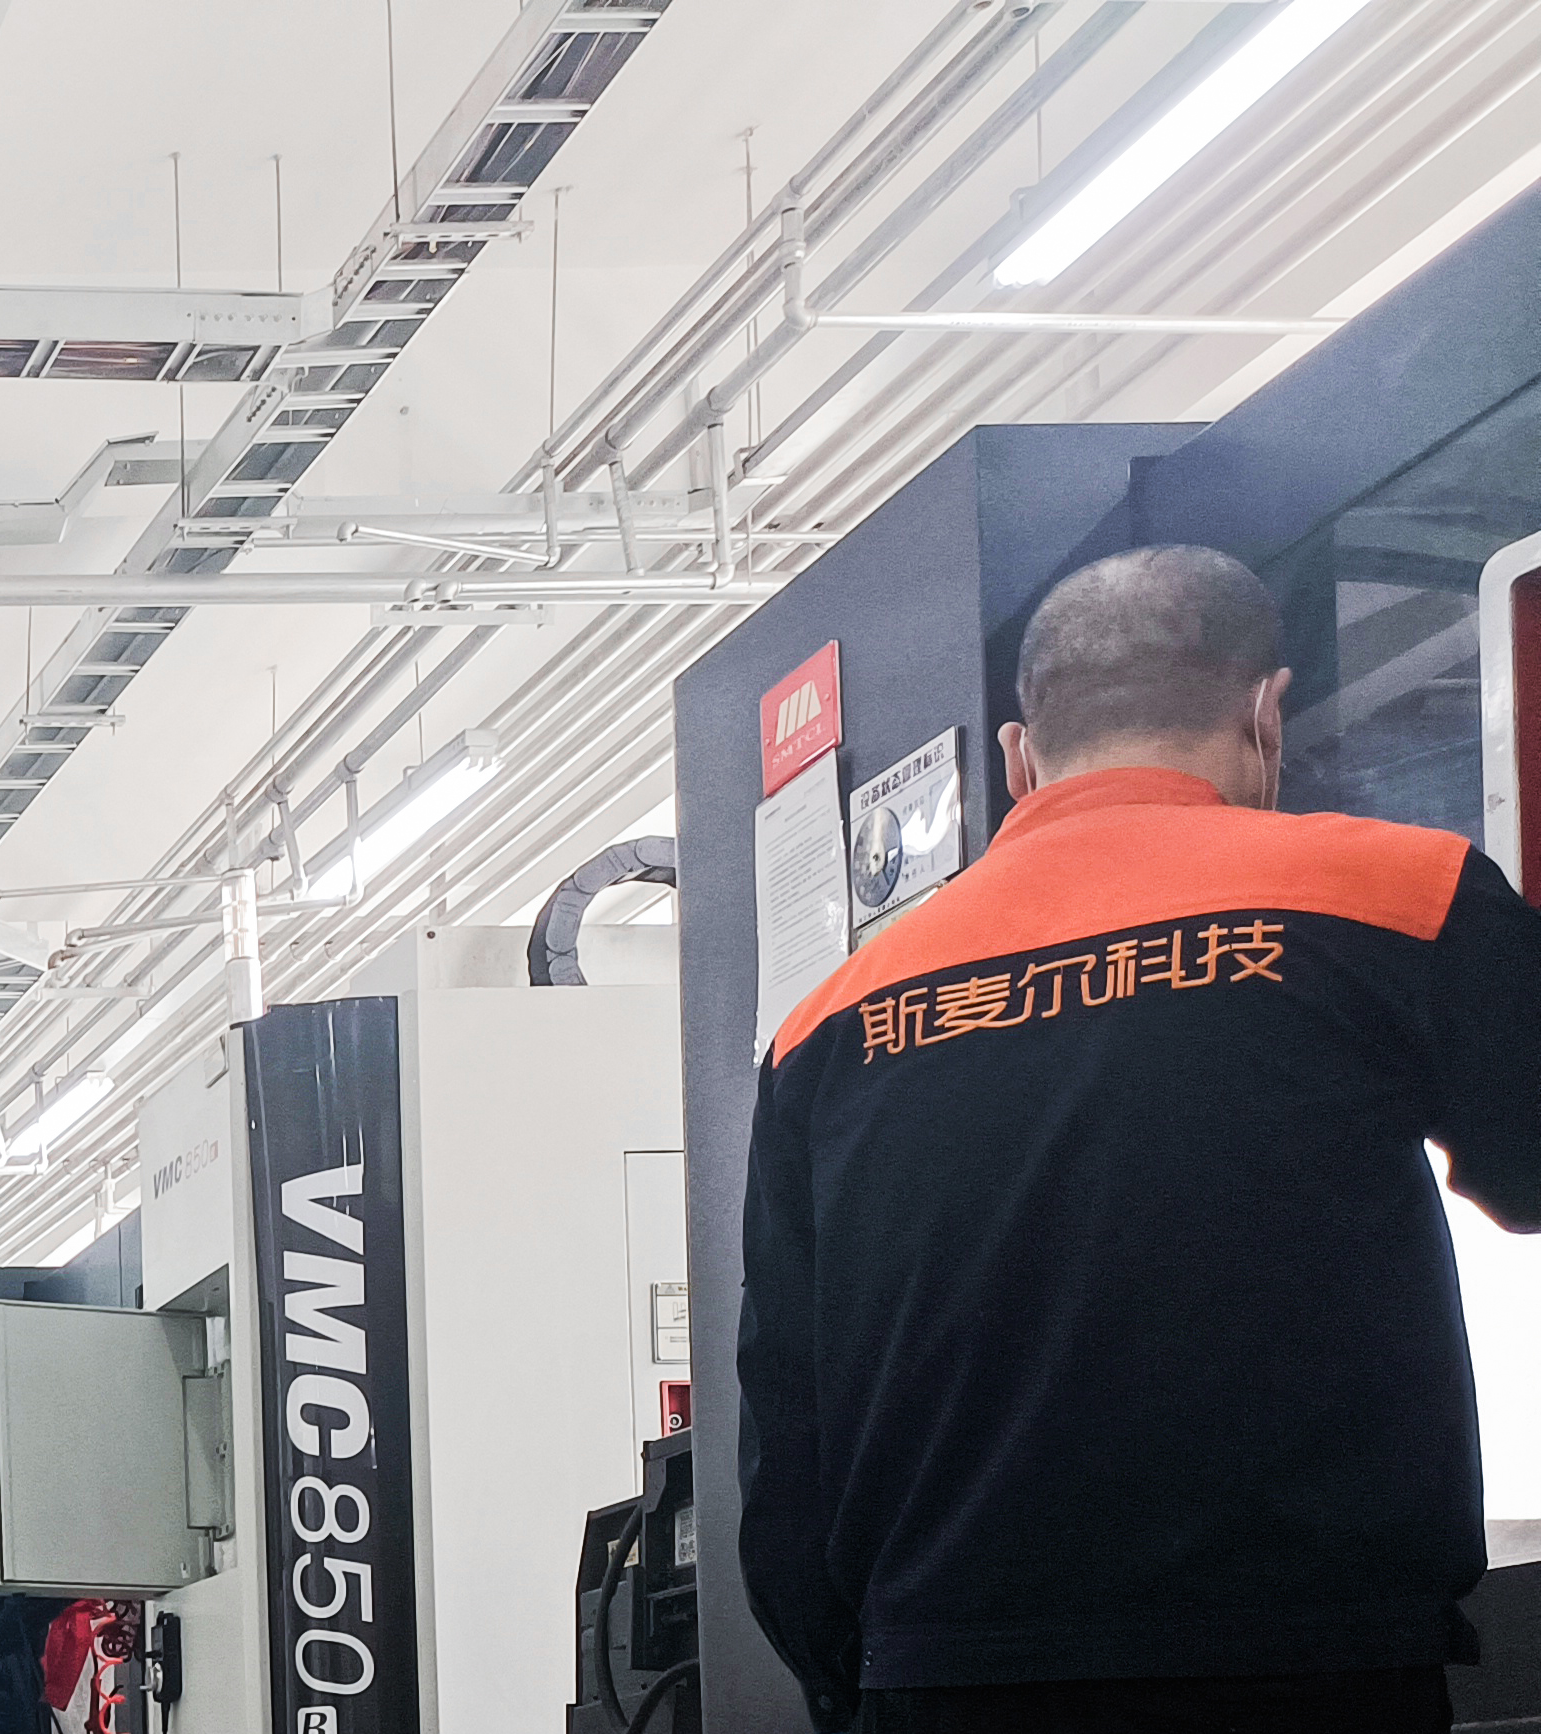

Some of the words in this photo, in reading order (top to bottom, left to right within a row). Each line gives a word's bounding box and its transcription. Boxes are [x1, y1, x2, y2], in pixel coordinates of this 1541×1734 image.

[771, 722, 826, 769] SMTCL
[859, 918, 1286, 1064] 斯麦尔科技
